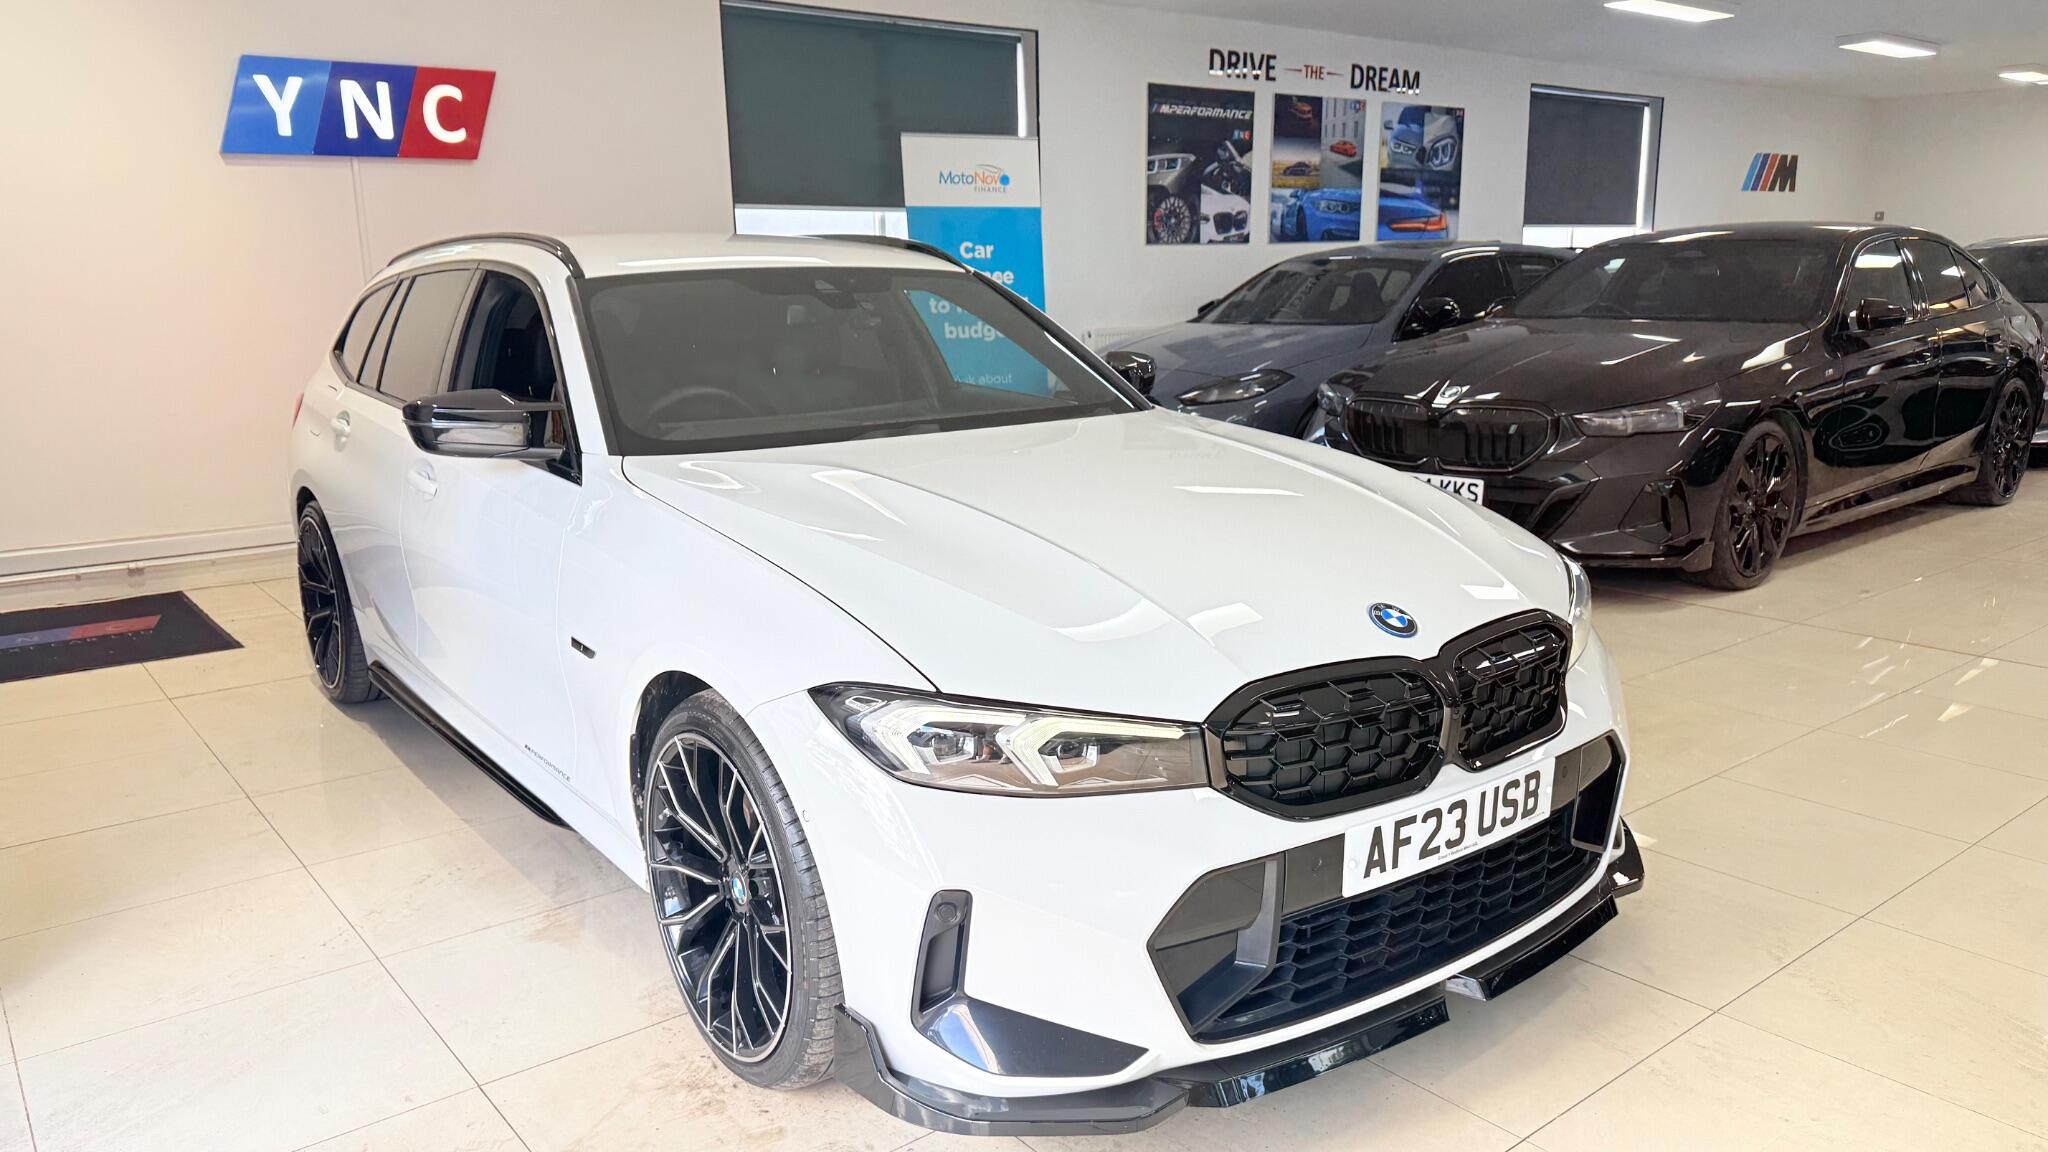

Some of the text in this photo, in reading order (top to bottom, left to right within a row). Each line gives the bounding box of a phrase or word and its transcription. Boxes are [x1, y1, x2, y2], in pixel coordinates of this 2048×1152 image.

[1208, 48, 1421, 95] DRIVE THE DREAM
[252, 74, 467, 144] YNC
[959, 241, 994, 259] Car
[928, 298, 950, 314] to
[944, 321, 1006, 341] budg
[1363, 769, 1541, 879] AF23 USB
